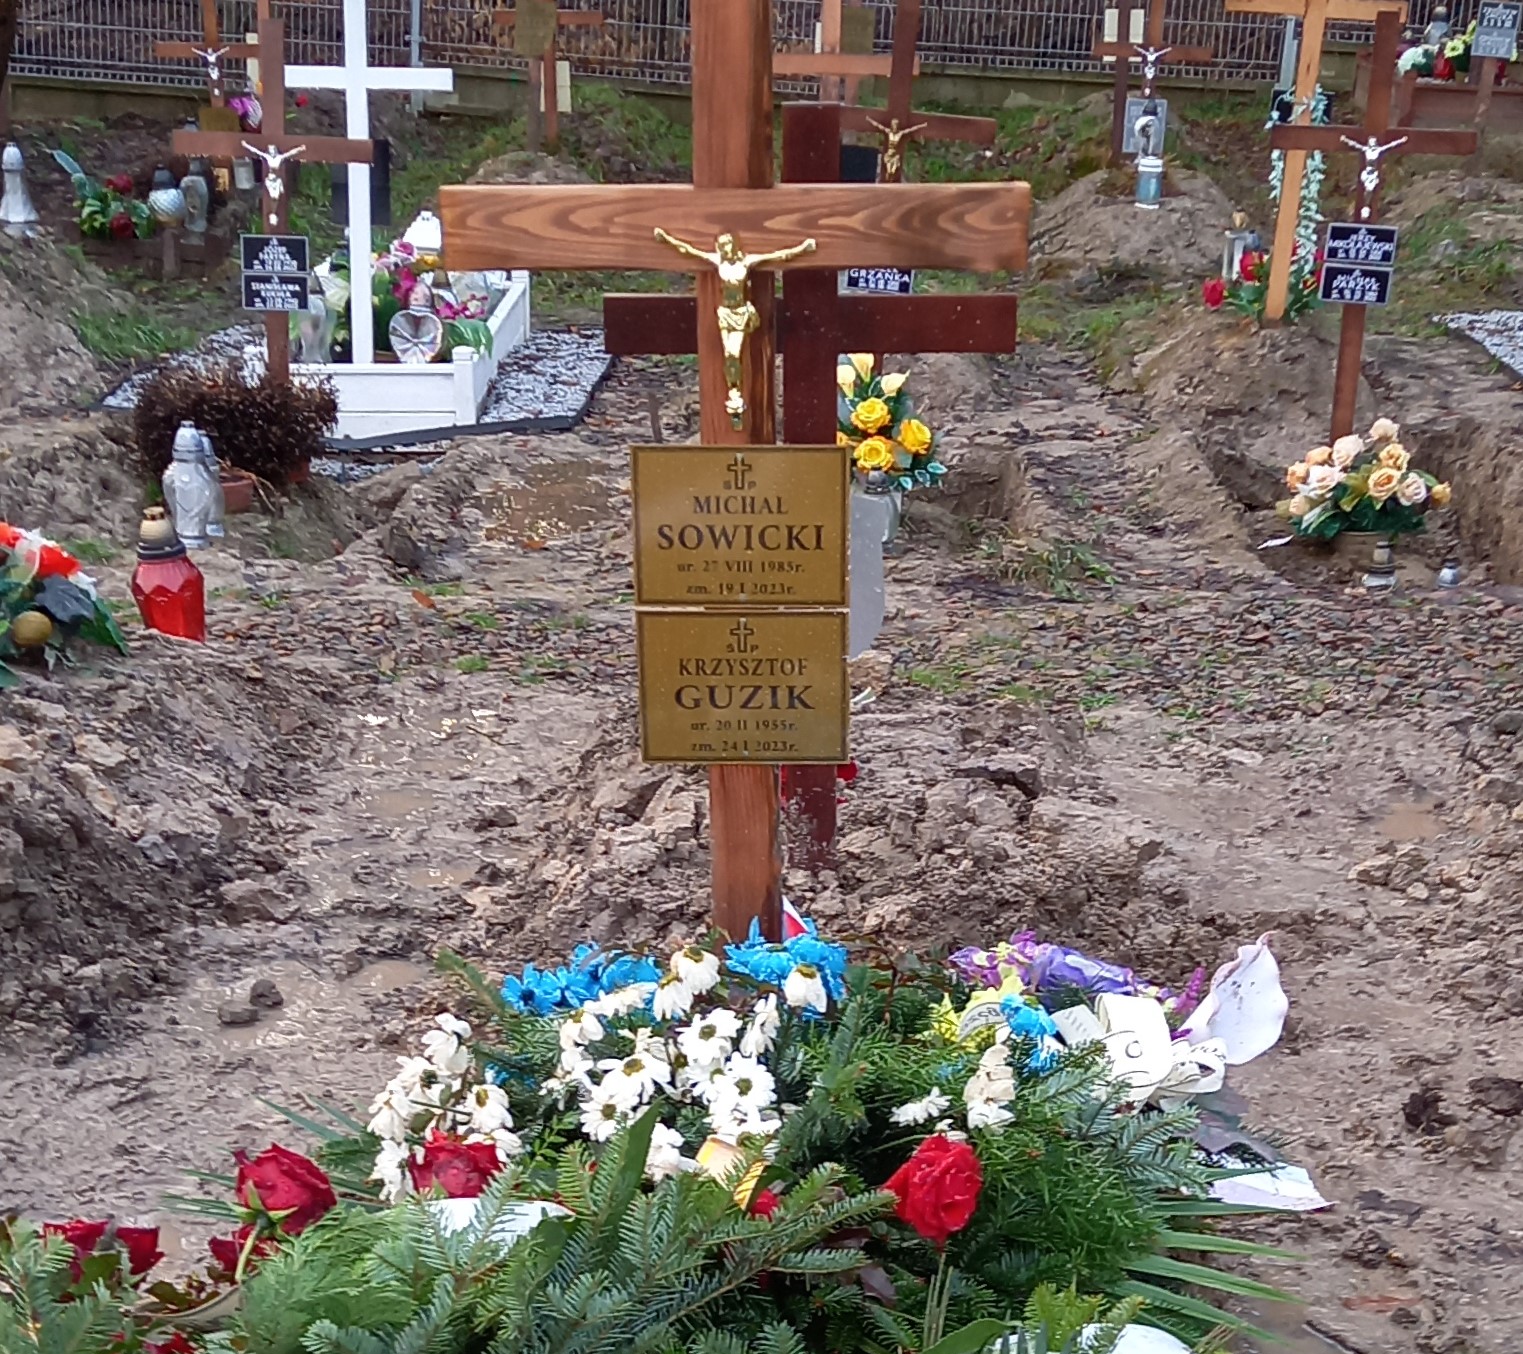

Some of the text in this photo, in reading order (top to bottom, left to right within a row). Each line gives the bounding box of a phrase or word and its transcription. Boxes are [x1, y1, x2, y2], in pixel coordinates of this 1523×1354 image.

[849, 268, 910, 282] GRZANKA
[657, 524, 825, 551] SOWICKI
[677, 562, 697, 573] ur.
[725, 560, 753, 574] VIII
[679, 658, 808, 676] KRZYSZTOF
[674, 684, 816, 710] GUZIK
[691, 721, 711, 731] ur.
